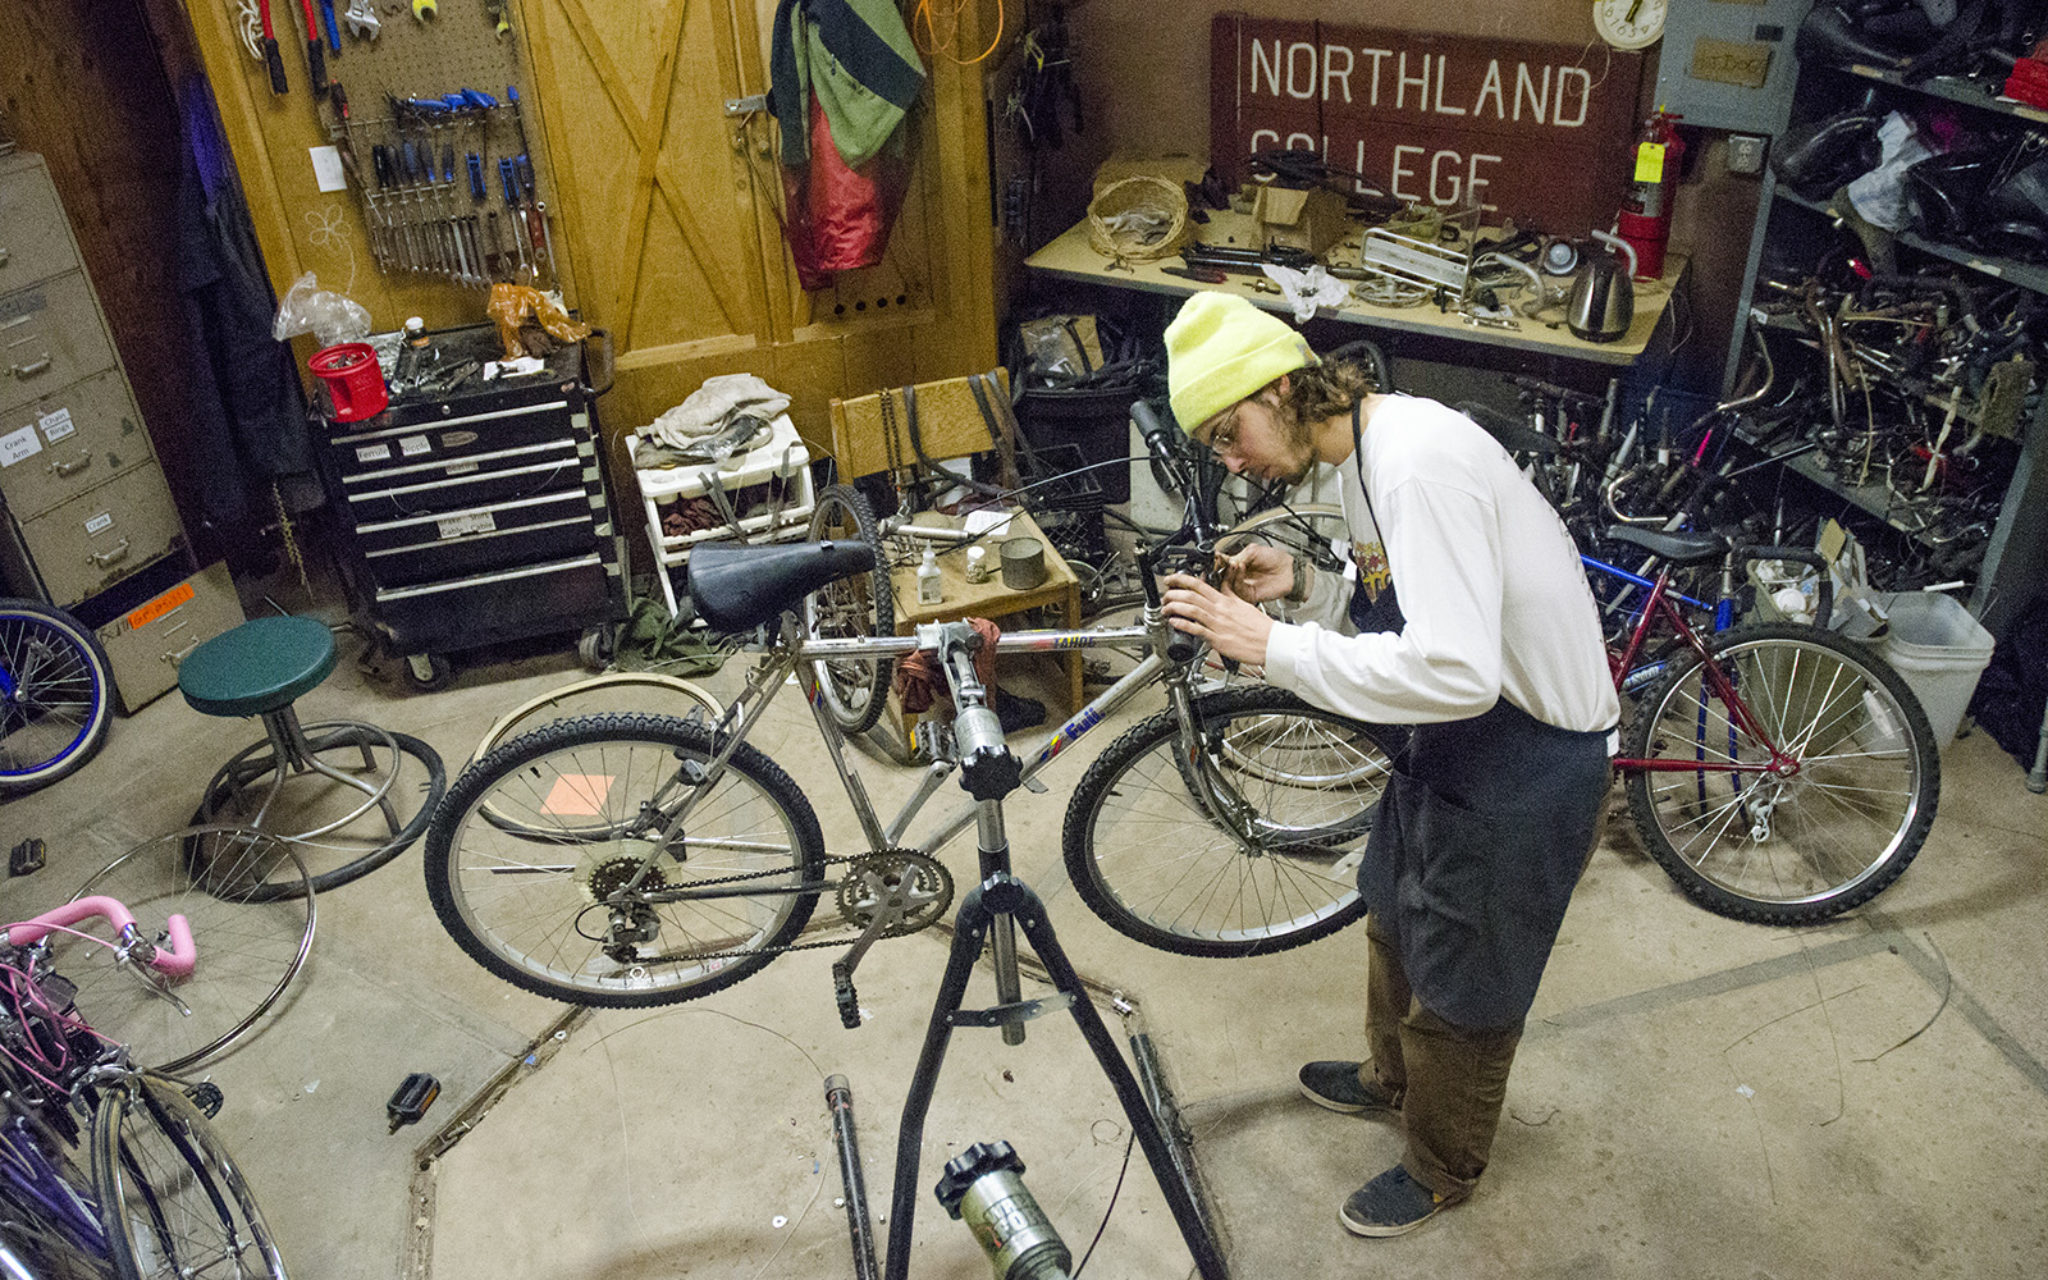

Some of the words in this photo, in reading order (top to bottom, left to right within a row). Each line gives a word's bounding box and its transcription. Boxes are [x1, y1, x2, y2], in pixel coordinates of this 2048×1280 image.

[1250, 37, 1592, 128] NORTHLAND
[4, 435, 28, 451] Crank
[12, 447, 31, 460] Arm
[1053, 634, 1097, 649] TAHOE
[1065, 707, 1102, 741] Fuji
